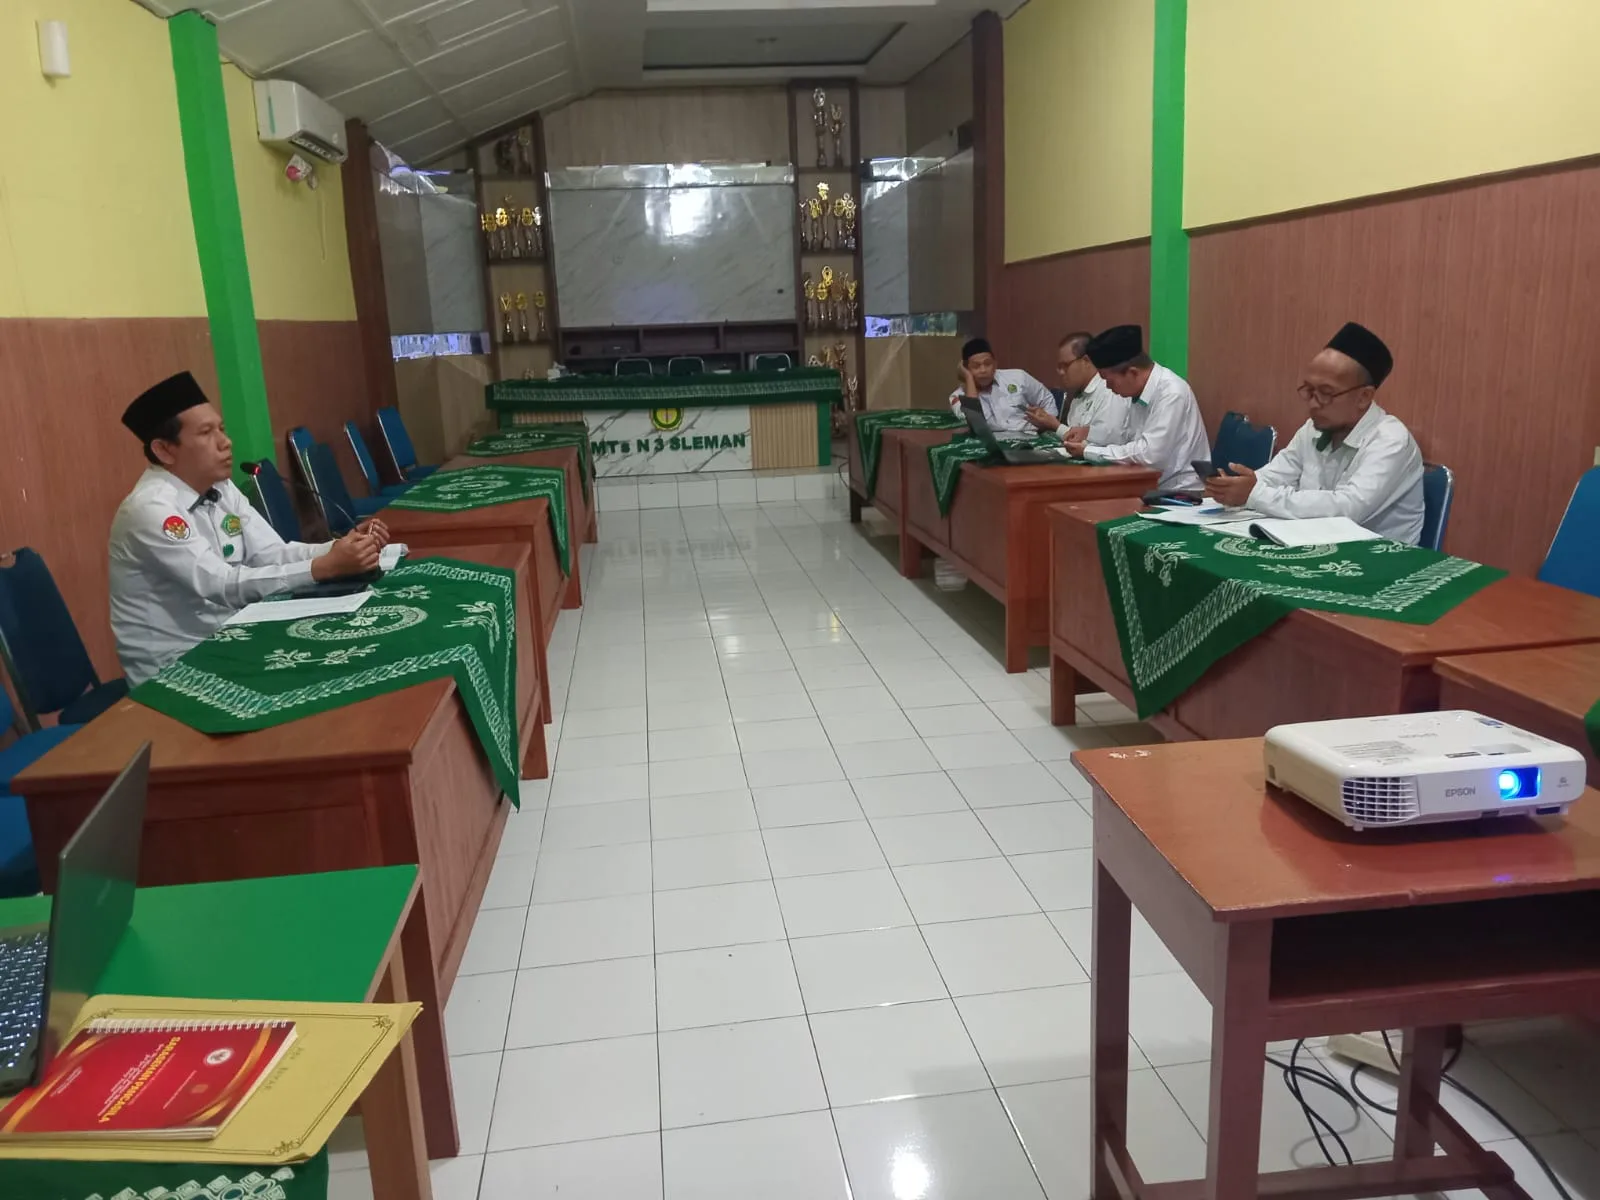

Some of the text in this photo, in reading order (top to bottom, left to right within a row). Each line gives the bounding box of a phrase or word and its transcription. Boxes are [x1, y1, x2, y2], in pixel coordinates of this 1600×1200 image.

[591, 432, 746, 456] MTs N 3 SLEMAN
[1445, 786, 1477, 798] EPSON
[138, 1036, 181, 1081] SARASEHAN
[98, 1081, 144, 1123] PANCASILA
